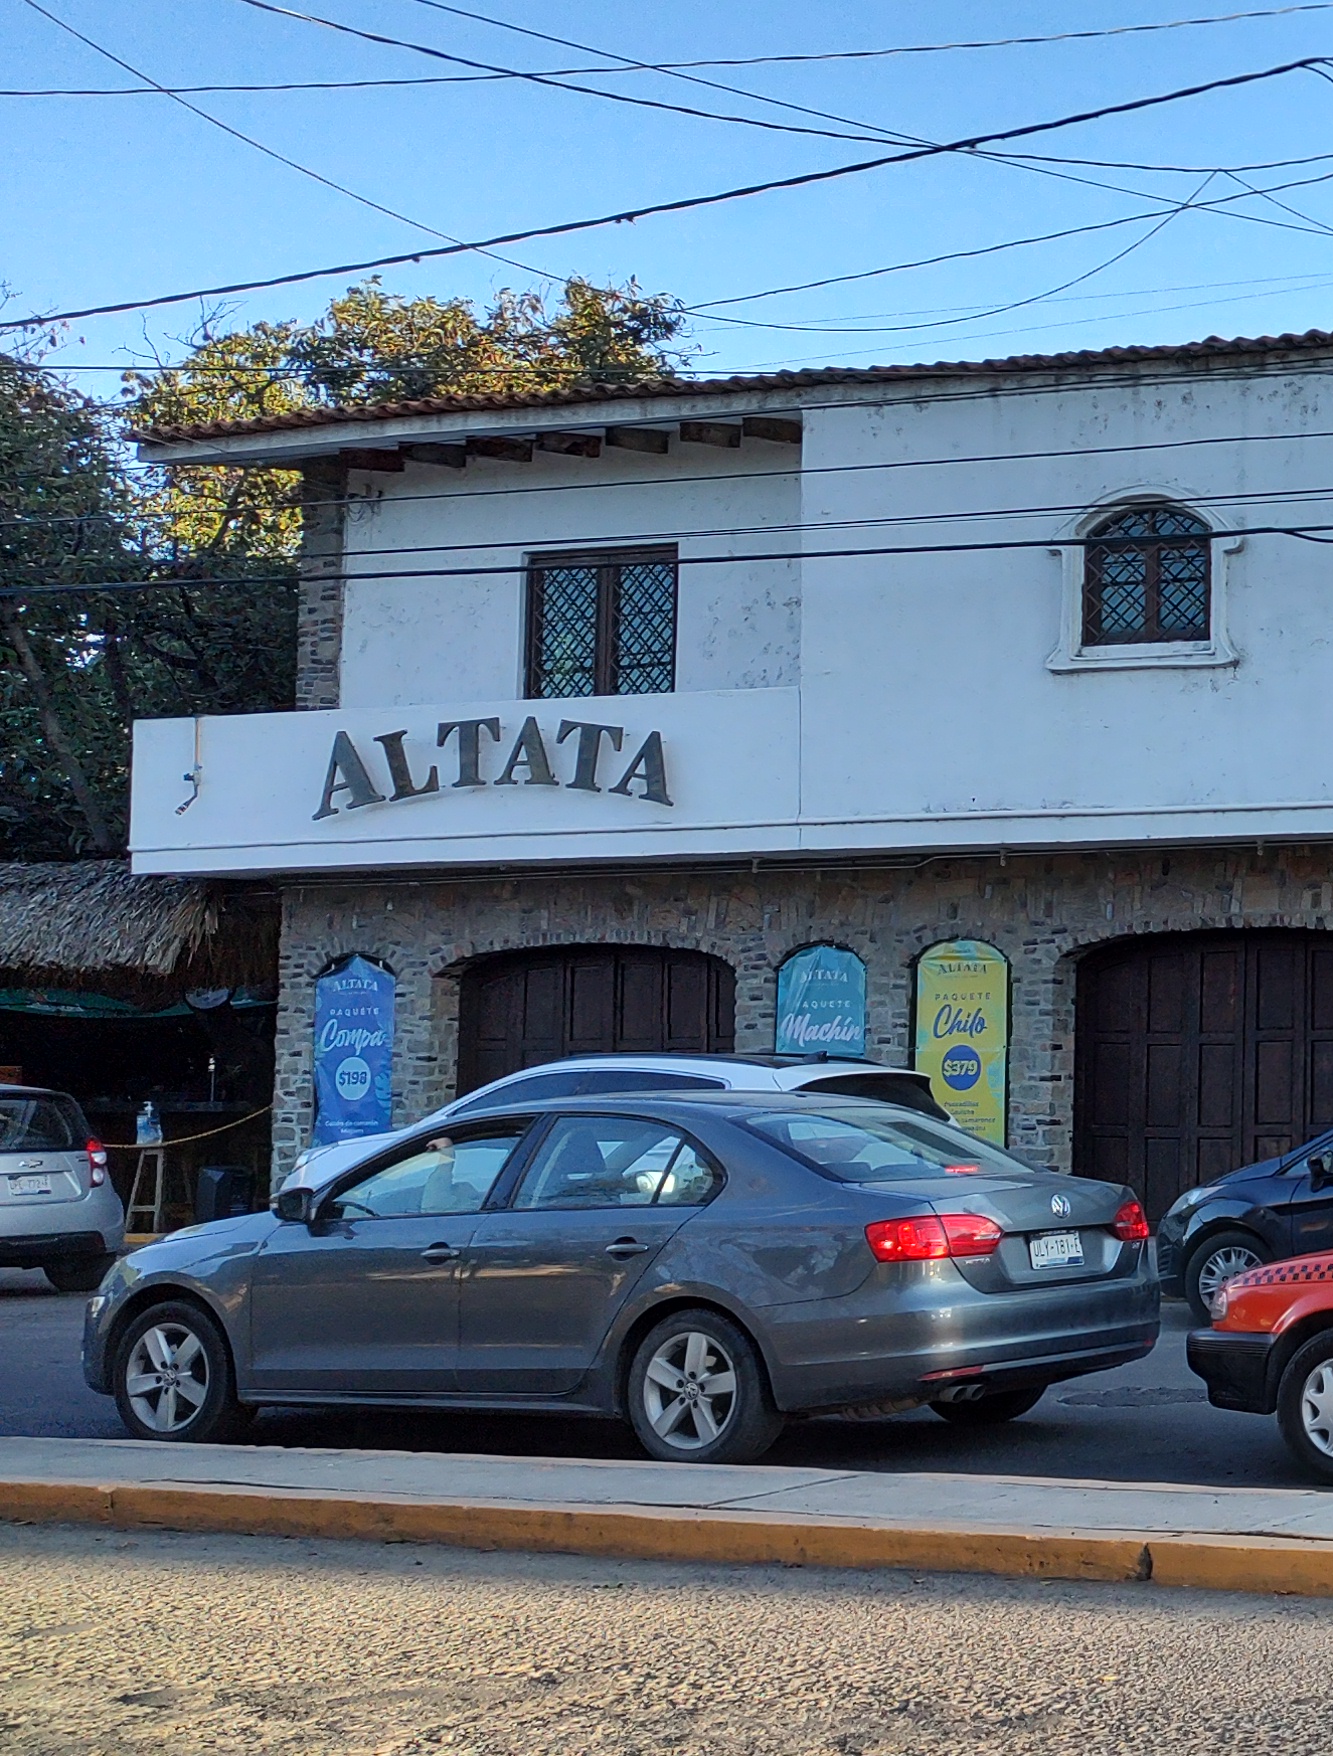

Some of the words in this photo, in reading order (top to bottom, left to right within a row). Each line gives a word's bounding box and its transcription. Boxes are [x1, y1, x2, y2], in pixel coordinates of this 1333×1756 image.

[311, 715, 675, 821] ALTATA
[332, 978, 379, 992] ALTATA
[798, 1000, 851, 1009] AQUETE
[934, 992, 991, 1001] PAQUETE
[932, 1004, 988, 1040] Chilo
[319, 1018, 387, 1056] Compa
[943, 1060, 978, 1078] $379
